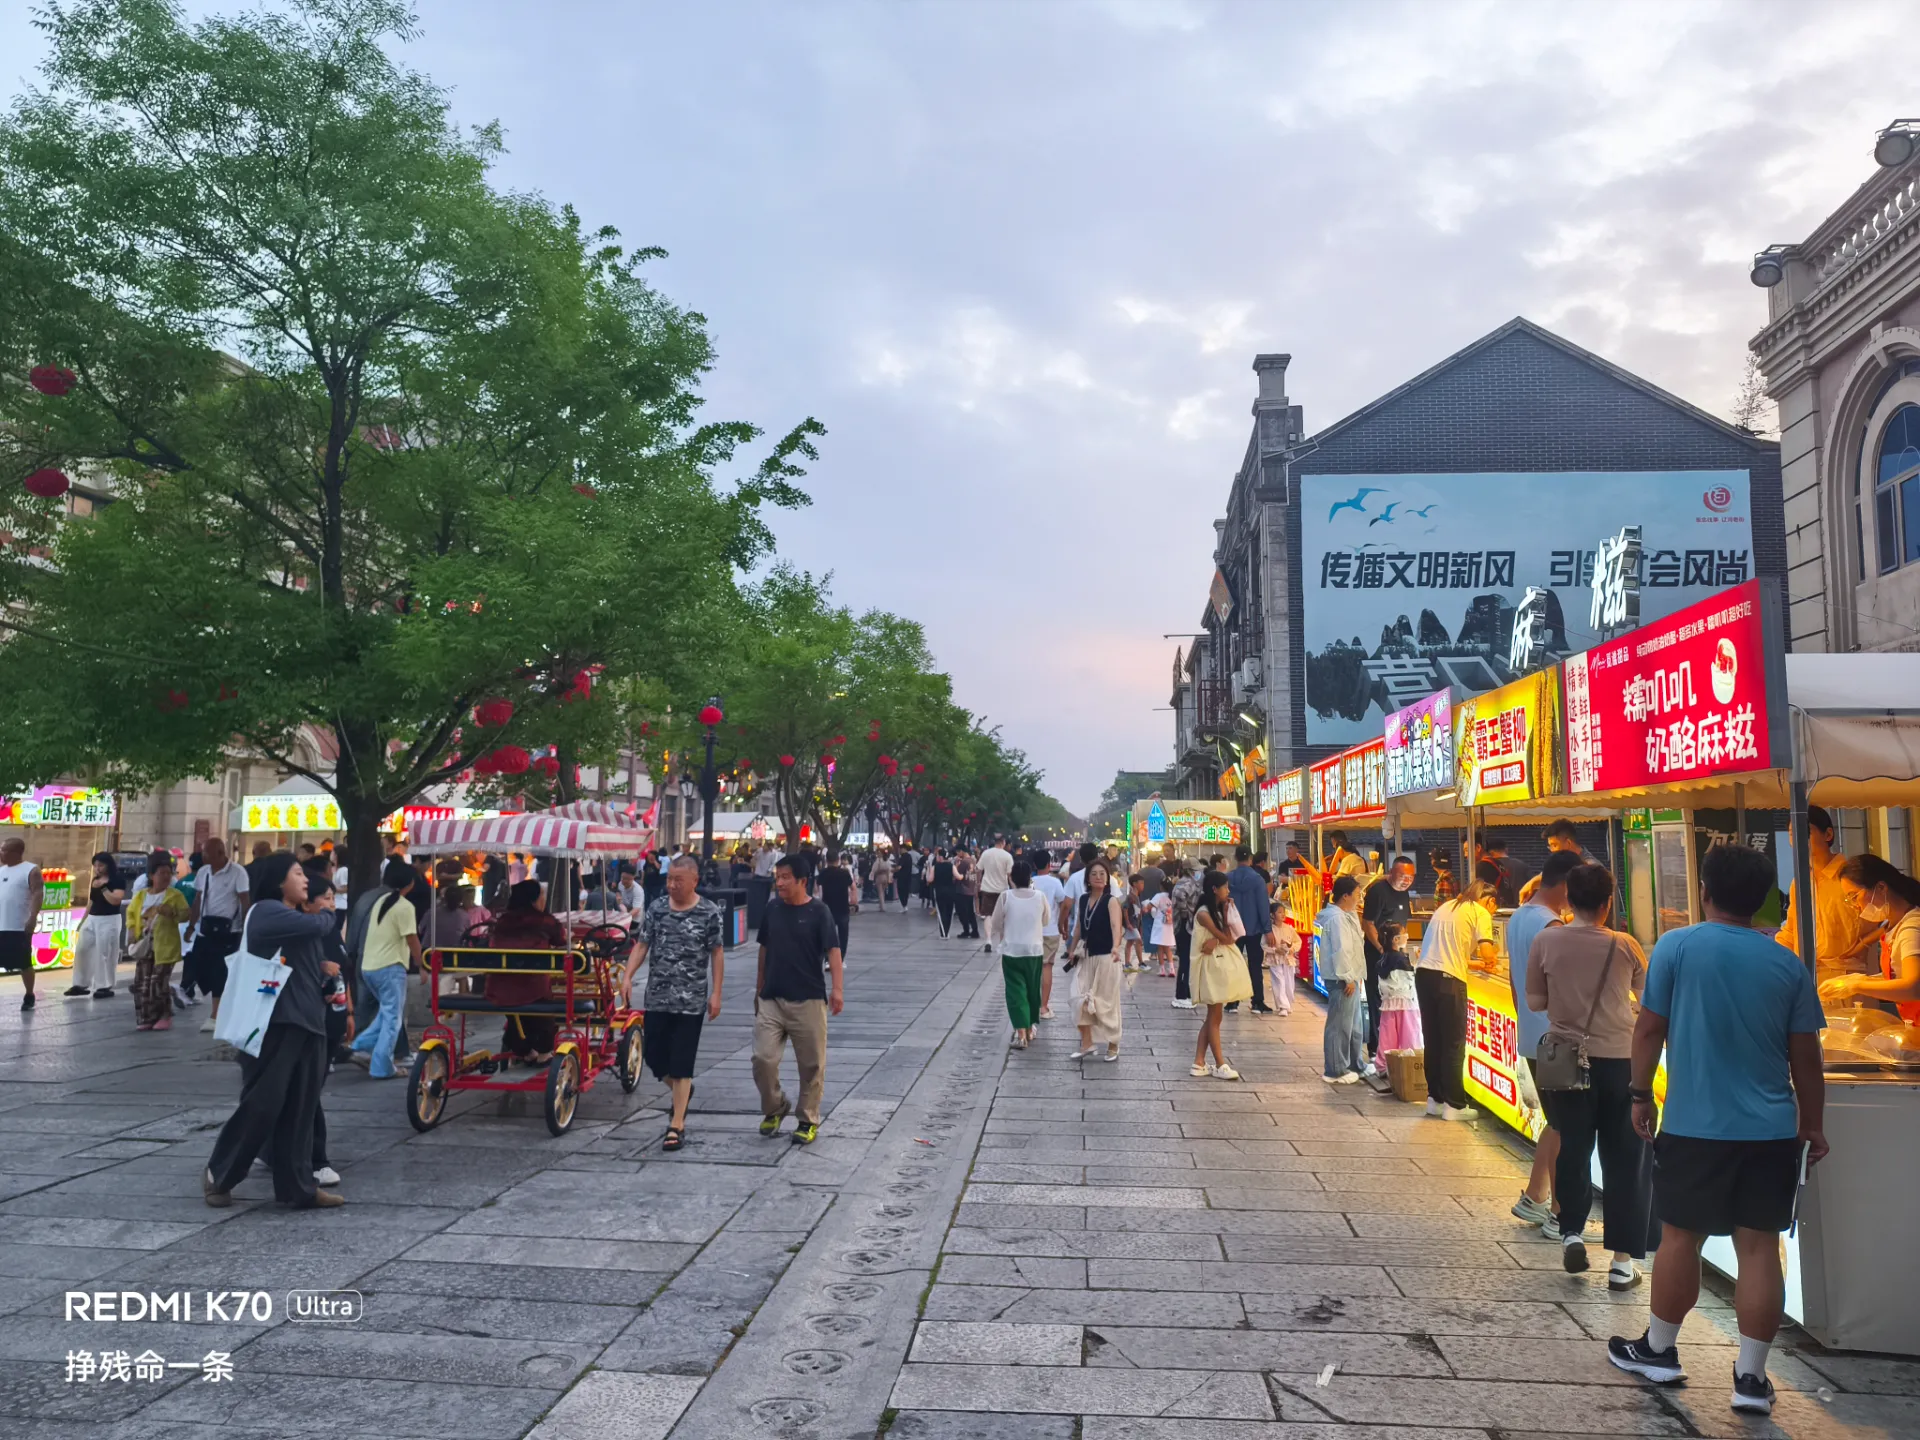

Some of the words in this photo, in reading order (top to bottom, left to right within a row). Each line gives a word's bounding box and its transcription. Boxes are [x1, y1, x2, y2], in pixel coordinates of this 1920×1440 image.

[1320, 550, 1516, 588] 传播文明新风
[1550, 549, 1749, 587] 引会风尚
[1577, 663, 1591, 783] 新鲜手作
[1622, 660, 1697, 723] 糯叽叽
[1475, 706, 1527, 762] 霸王蟹柳
[1567, 664, 1581, 785] 精选水果
[1645, 702, 1758, 774] 奶酪麻糍
[42, 797, 113, 823] 喝杯果汁
[1203, 825, 1232, 842] 油边
[1465, 998, 1518, 1070] 霸王蟹柳
